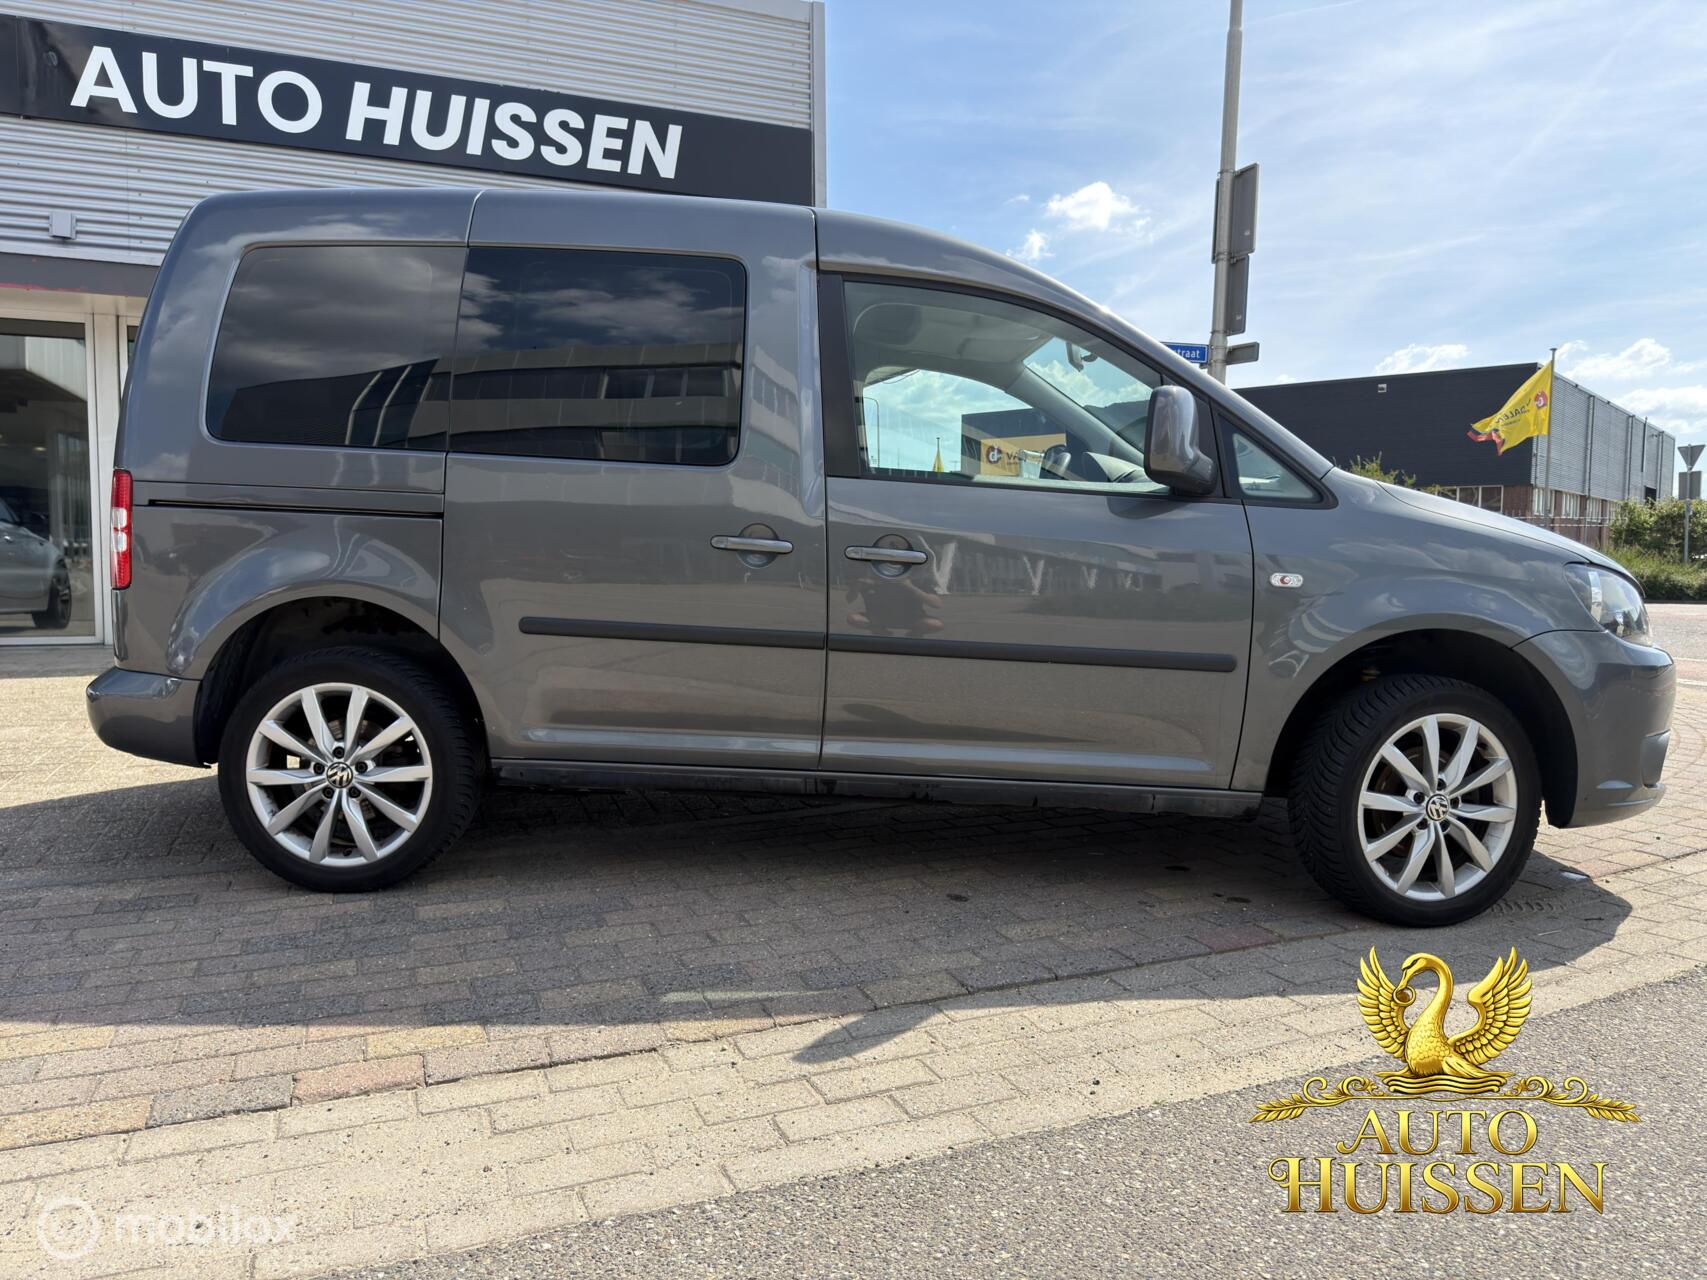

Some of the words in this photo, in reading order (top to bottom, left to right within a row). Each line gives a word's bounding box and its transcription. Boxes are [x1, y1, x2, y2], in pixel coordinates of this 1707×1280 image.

[70, 45, 322, 134] AUTO
[345, 81, 683, 179] HUISSEN
[1174, 348, 1201, 359] traat
